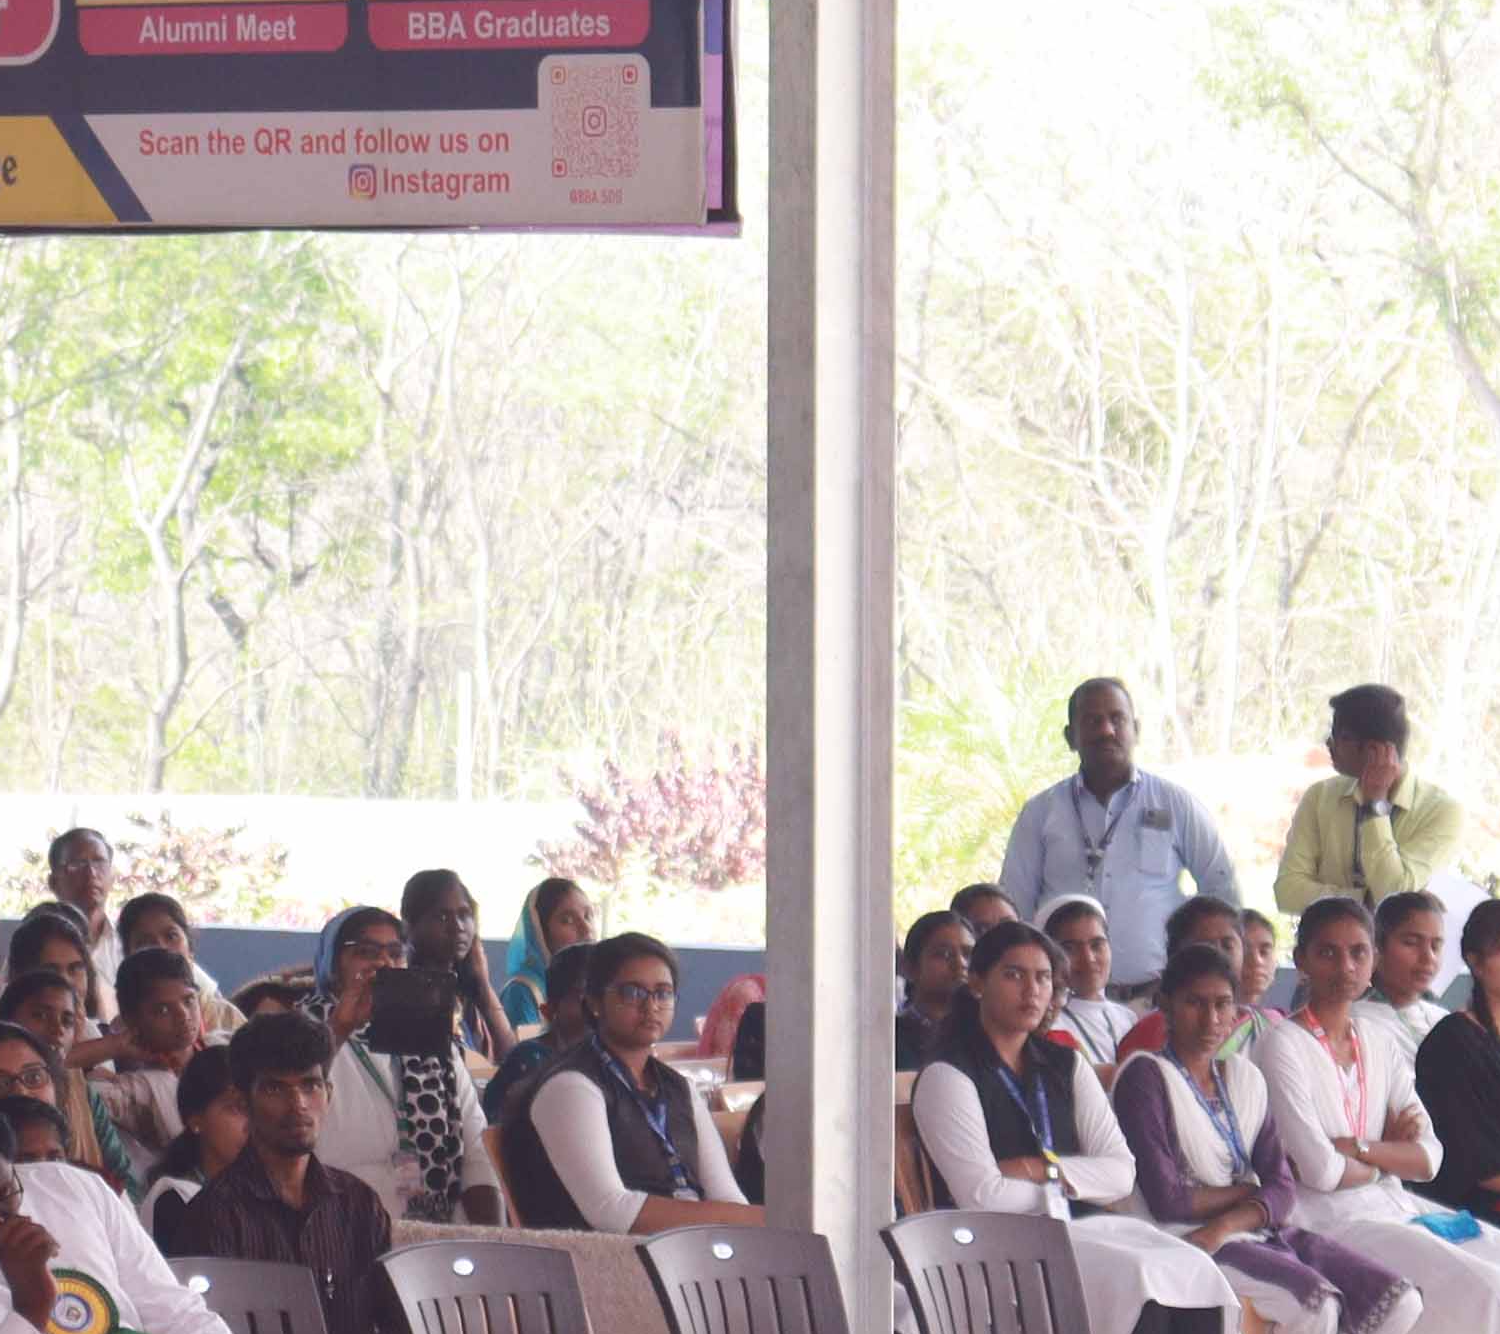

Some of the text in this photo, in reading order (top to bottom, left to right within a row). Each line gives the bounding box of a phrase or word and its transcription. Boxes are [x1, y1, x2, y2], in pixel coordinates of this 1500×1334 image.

[139, 14, 296, 43] Alumni Meet
[408, 8, 611, 40] BBA Graduates
[138, 127, 511, 157] Scan the QR and follow us on
[383, 168, 511, 201] Instagram
